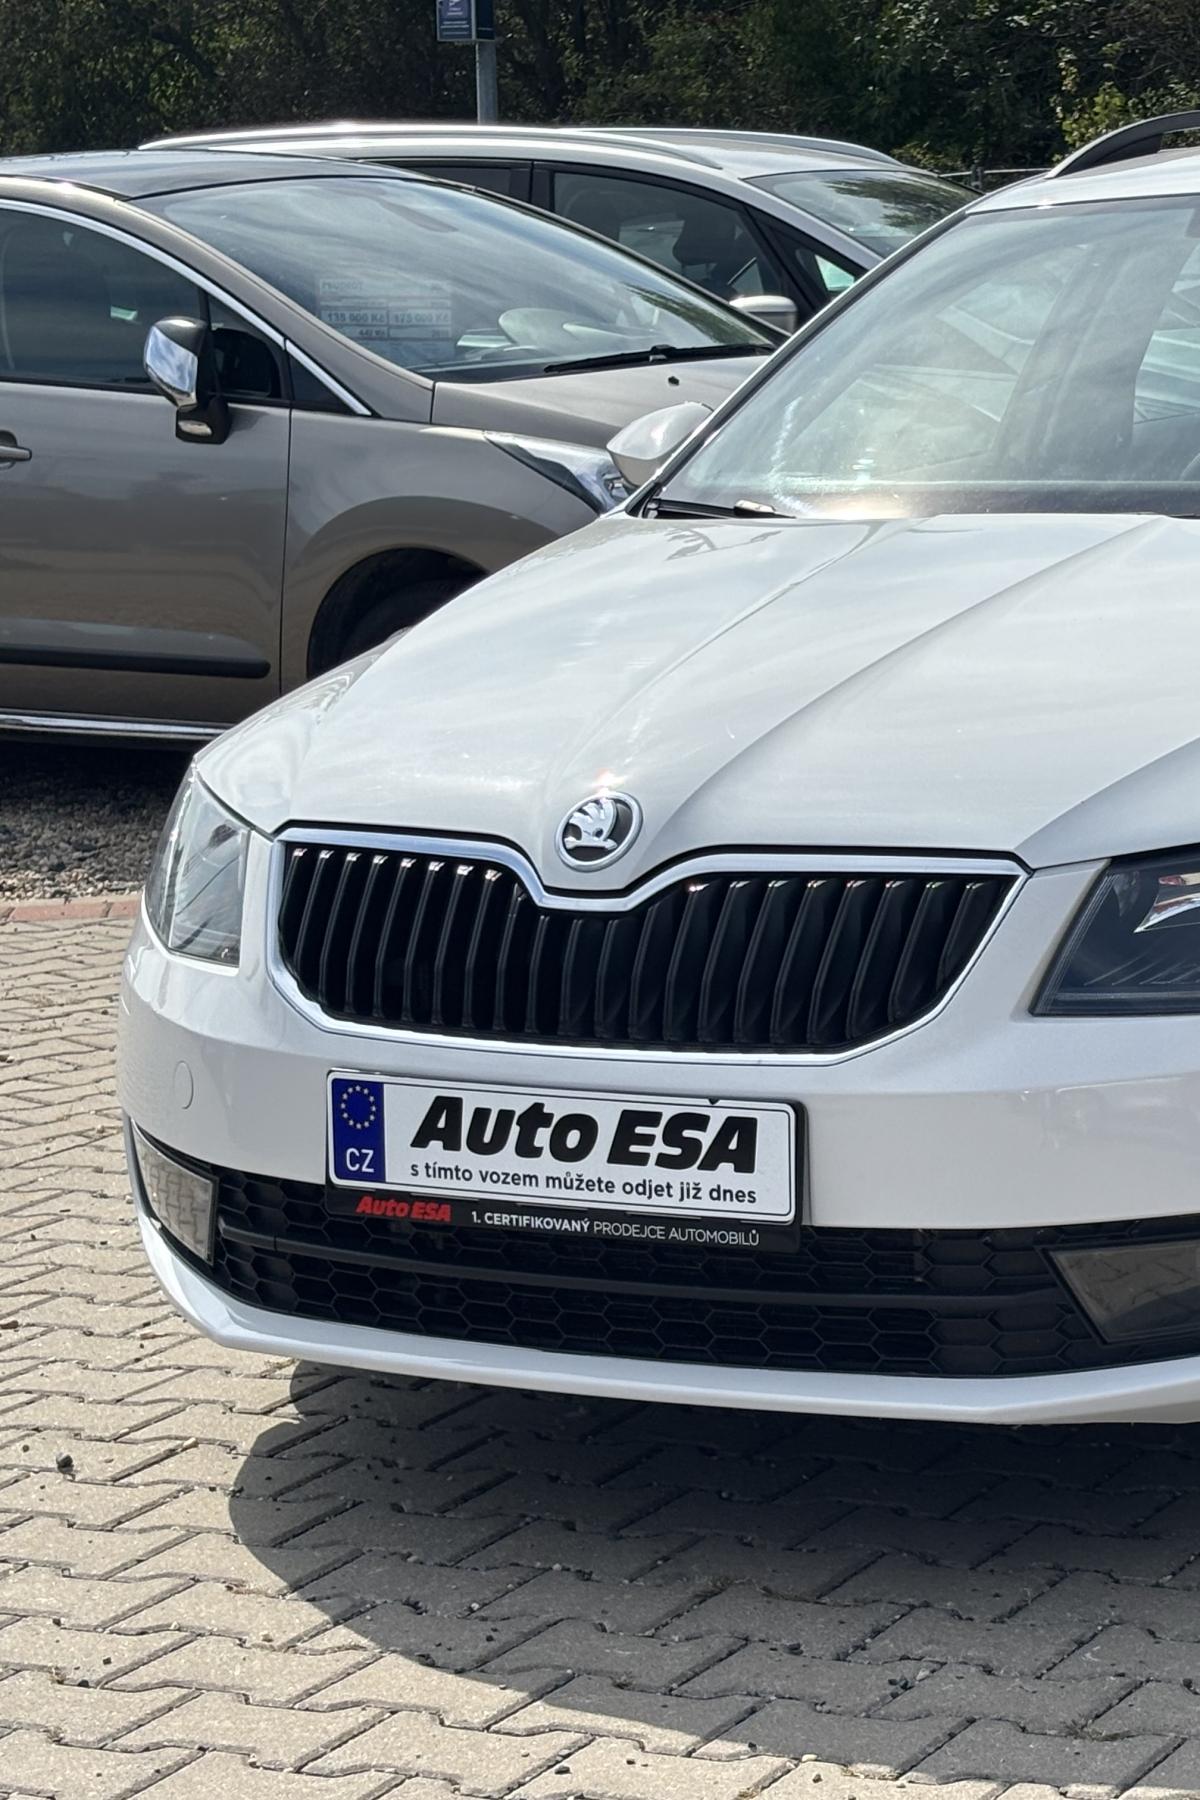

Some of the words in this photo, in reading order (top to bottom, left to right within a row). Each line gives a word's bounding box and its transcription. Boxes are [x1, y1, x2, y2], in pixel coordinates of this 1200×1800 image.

[410, 1095, 598, 1163] Auto
[606, 1109, 758, 1174] ESA
[345, 1147, 375, 1173] CZ
[410, 1162, 420, 1177] s
[425, 1161, 473, 1182] tímto
[478, 1168, 539, 1188] vozem
[545, 1171, 616, 1194] můžete
[622, 1178, 673, 1200] odjet
[678, 1181, 702, 1202] již
[708, 1184, 757, 1204] dnes
[354, 1195, 409, 1218] Auto
[410, 1202, 453, 1222] ESA
[471, 1210, 481, 1224] 1.
[484, 1211, 591, 1233] CERTIFIKOVANÝ
[593, 1220, 666, 1240] PRODEJCE
[668, 1227, 760, 1246] AUTOMOBILŮ
